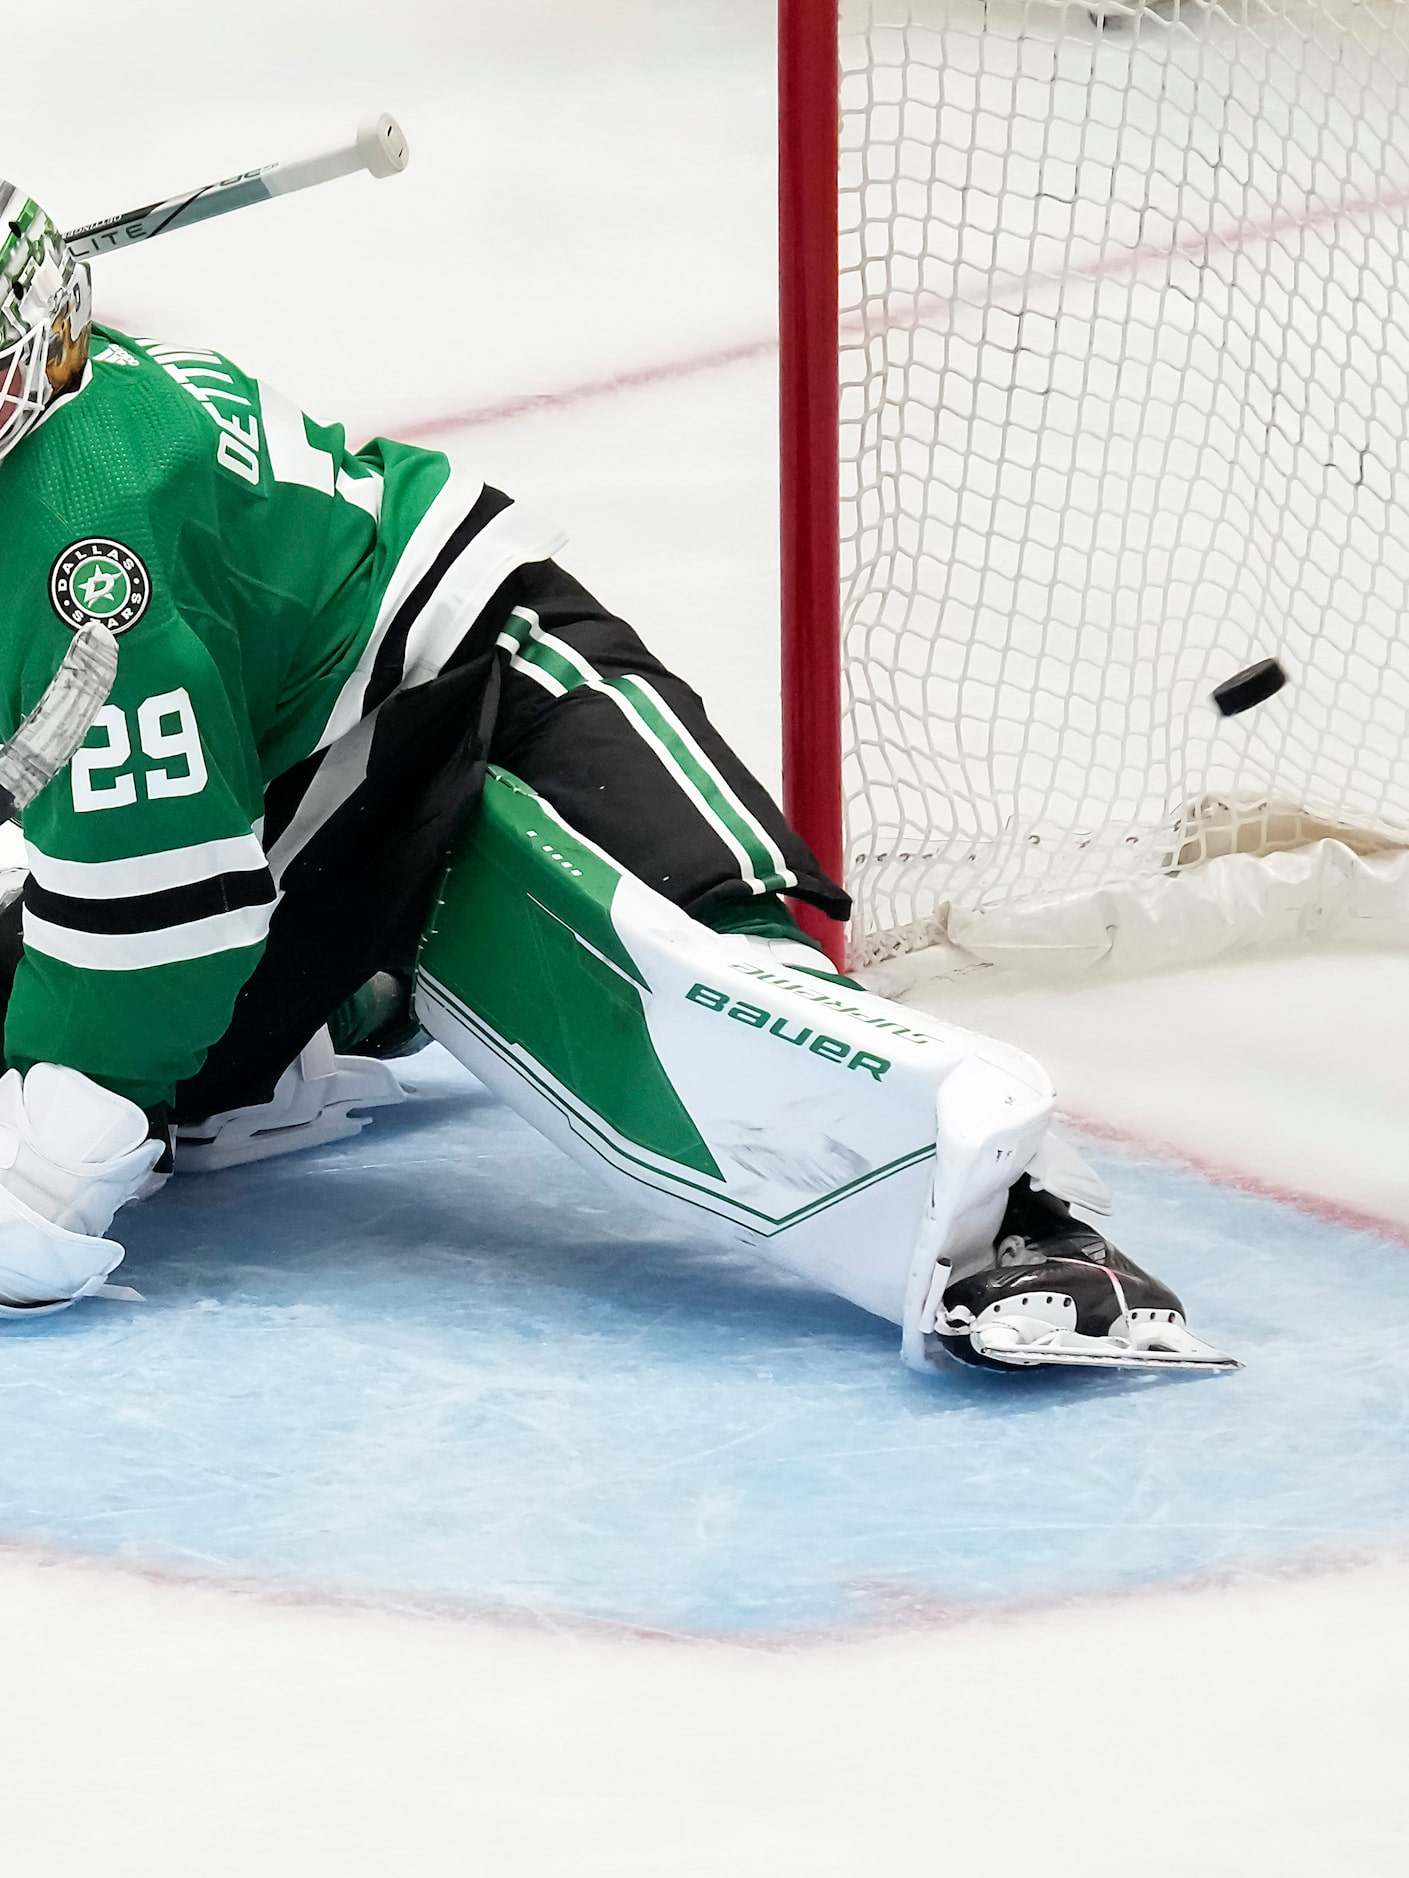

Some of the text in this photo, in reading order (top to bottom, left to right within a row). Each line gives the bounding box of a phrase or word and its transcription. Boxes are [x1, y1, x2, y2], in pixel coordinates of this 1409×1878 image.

[57, 544, 135, 592] DALLAS
[70, 686, 208, 814] 29
[685, 982, 892, 1083] BAUER
